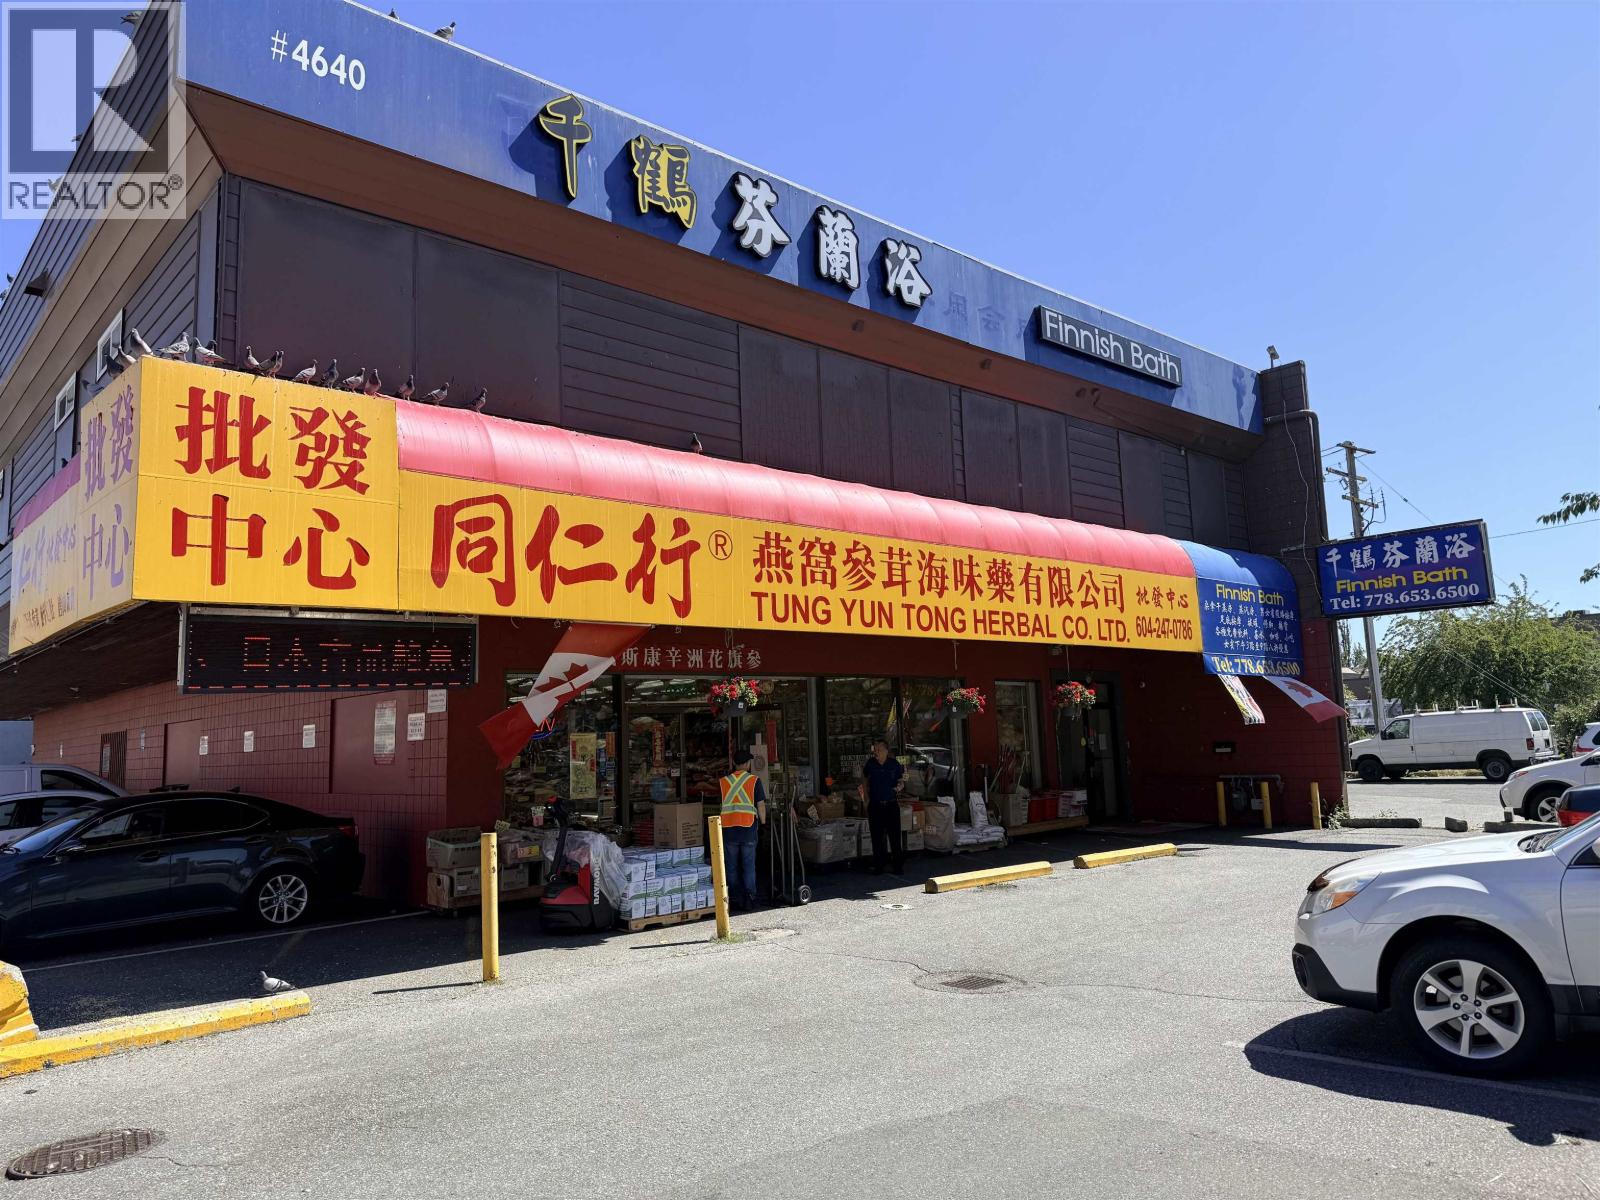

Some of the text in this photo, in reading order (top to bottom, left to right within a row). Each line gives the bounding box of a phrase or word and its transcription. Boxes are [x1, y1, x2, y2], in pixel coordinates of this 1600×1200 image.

[271, 30, 366, 91] #4640
[1046, 310, 1124, 364] Finnish
[1130, 343, 1180, 383] Bath
[175, 386, 372, 495] 批發
[172, 494, 370, 590] 中心
[430, 493, 701, 619] 同仁行
[1325, 532, 1475, 577] 千鶴芬蘭浴
[753, 530, 1189, 613] 燕窩參茸海味藥有限公司 批發中心
[1216, 583, 1285, 606] Finnish Bath
[1330, 583, 1480, 610] Tel: 778.653.6500
[1336, 566, 1468, 594] Finnish Bath
[751, 591, 1193, 643] TUNG YUN TONG HERBAL CO. LTD. 604-247-0786
[613, 645, 762, 669] 斯康辛洲花旗參
[1212, 656, 1300, 675] Tel: 778.653.6500
